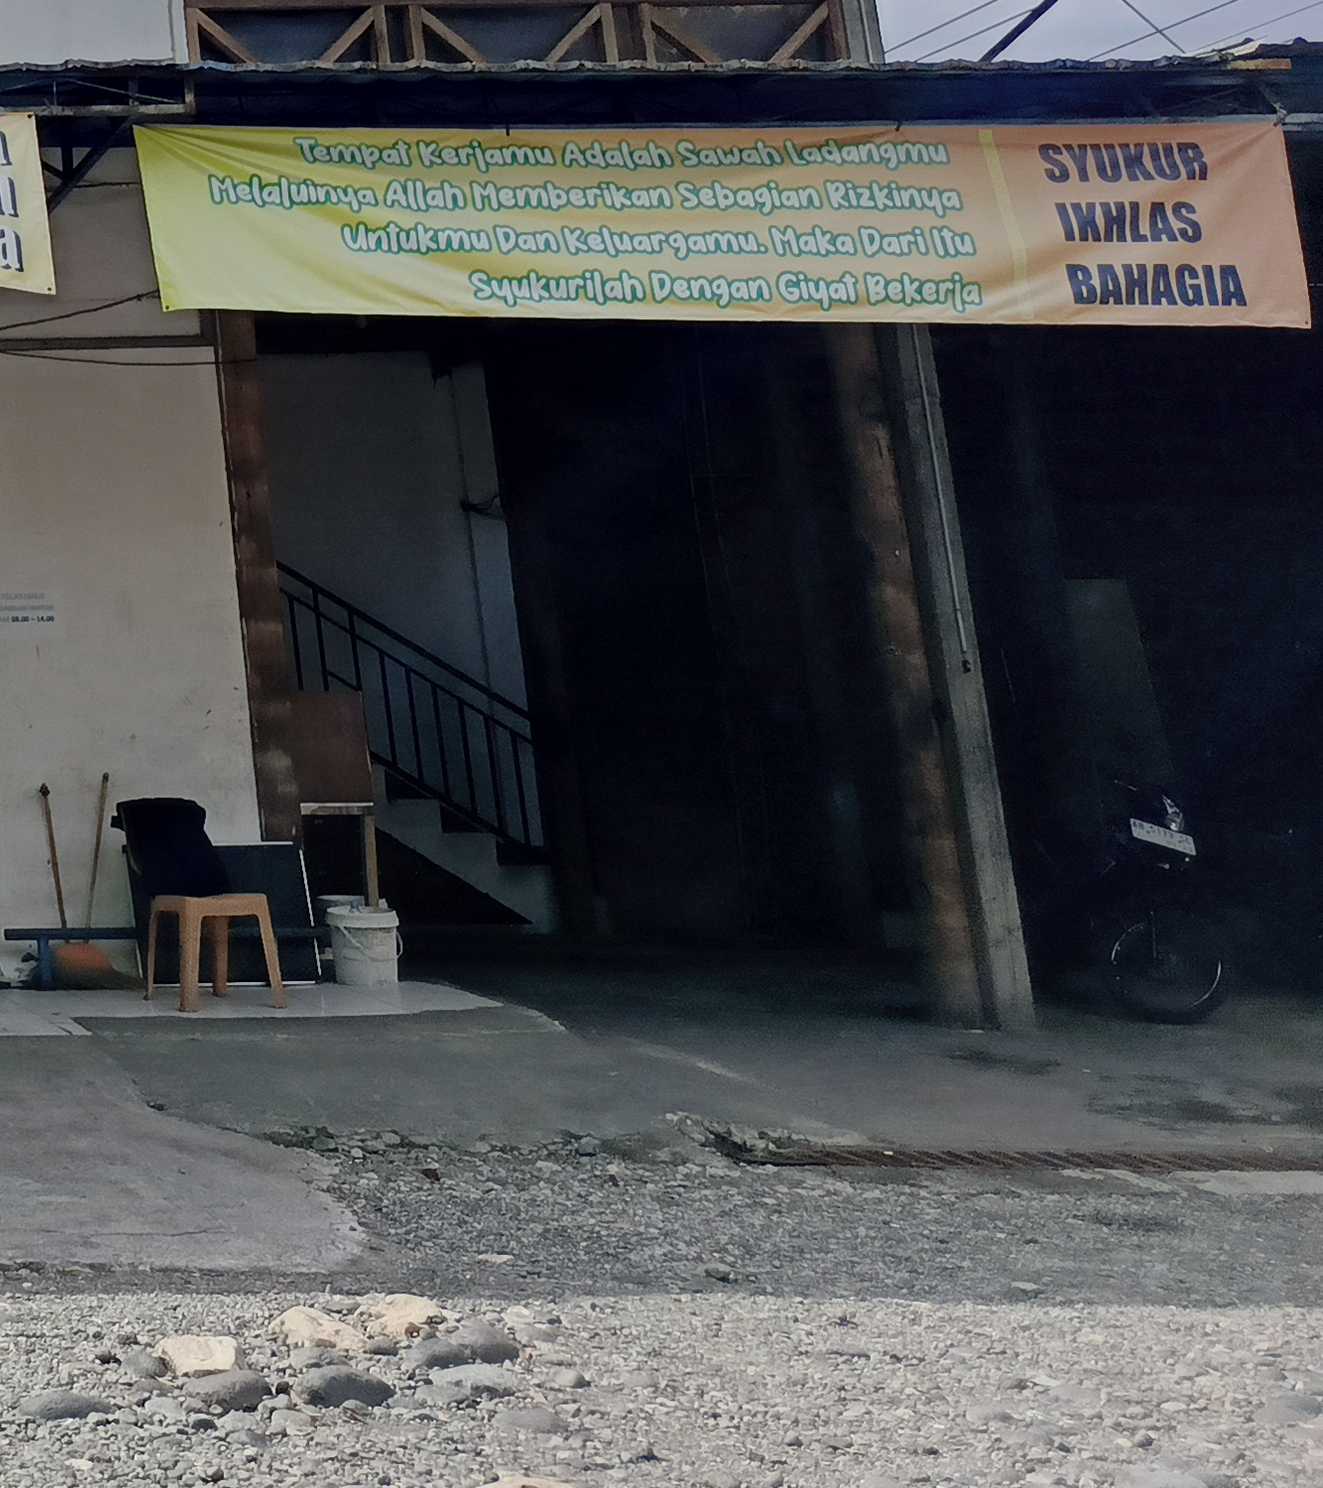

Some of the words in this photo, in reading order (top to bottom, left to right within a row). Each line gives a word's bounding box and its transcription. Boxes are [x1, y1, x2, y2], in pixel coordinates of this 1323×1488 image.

[295, 137, 411, 169] Tempat
[417, 140, 555, 172] Kerjamu
[563, 140, 674, 170] Adalah
[676, 139, 783, 167] Sawah
[784, 139, 950, 170] Ladangmu
[1038, 142, 1208, 183] SYUKUR
[208, 175, 377, 213] Melaluinya
[383, 177, 466, 210] Allah
[469, 181, 673, 212] Memberikan
[675, 180, 823, 216] Sebagian
[823, 179, 963, 218] Rizkinya
[341, 223, 491, 255] Untukmu
[493, 225, 560, 254] Dan
[768, 224, 857, 257] Maka
[858, 226, 929, 258] Dari
[929, 225, 977, 258] Itu
[1055, 201, 1202, 243] IKHLAS
[469, 269, 646, 308] Syukurilah
[649, 269, 772, 309] Dengan
[776, 271, 858, 311] Giyat
[863, 272, 983, 313] Bekerja
[1065, 263, 1247, 306] BAHAGIA
